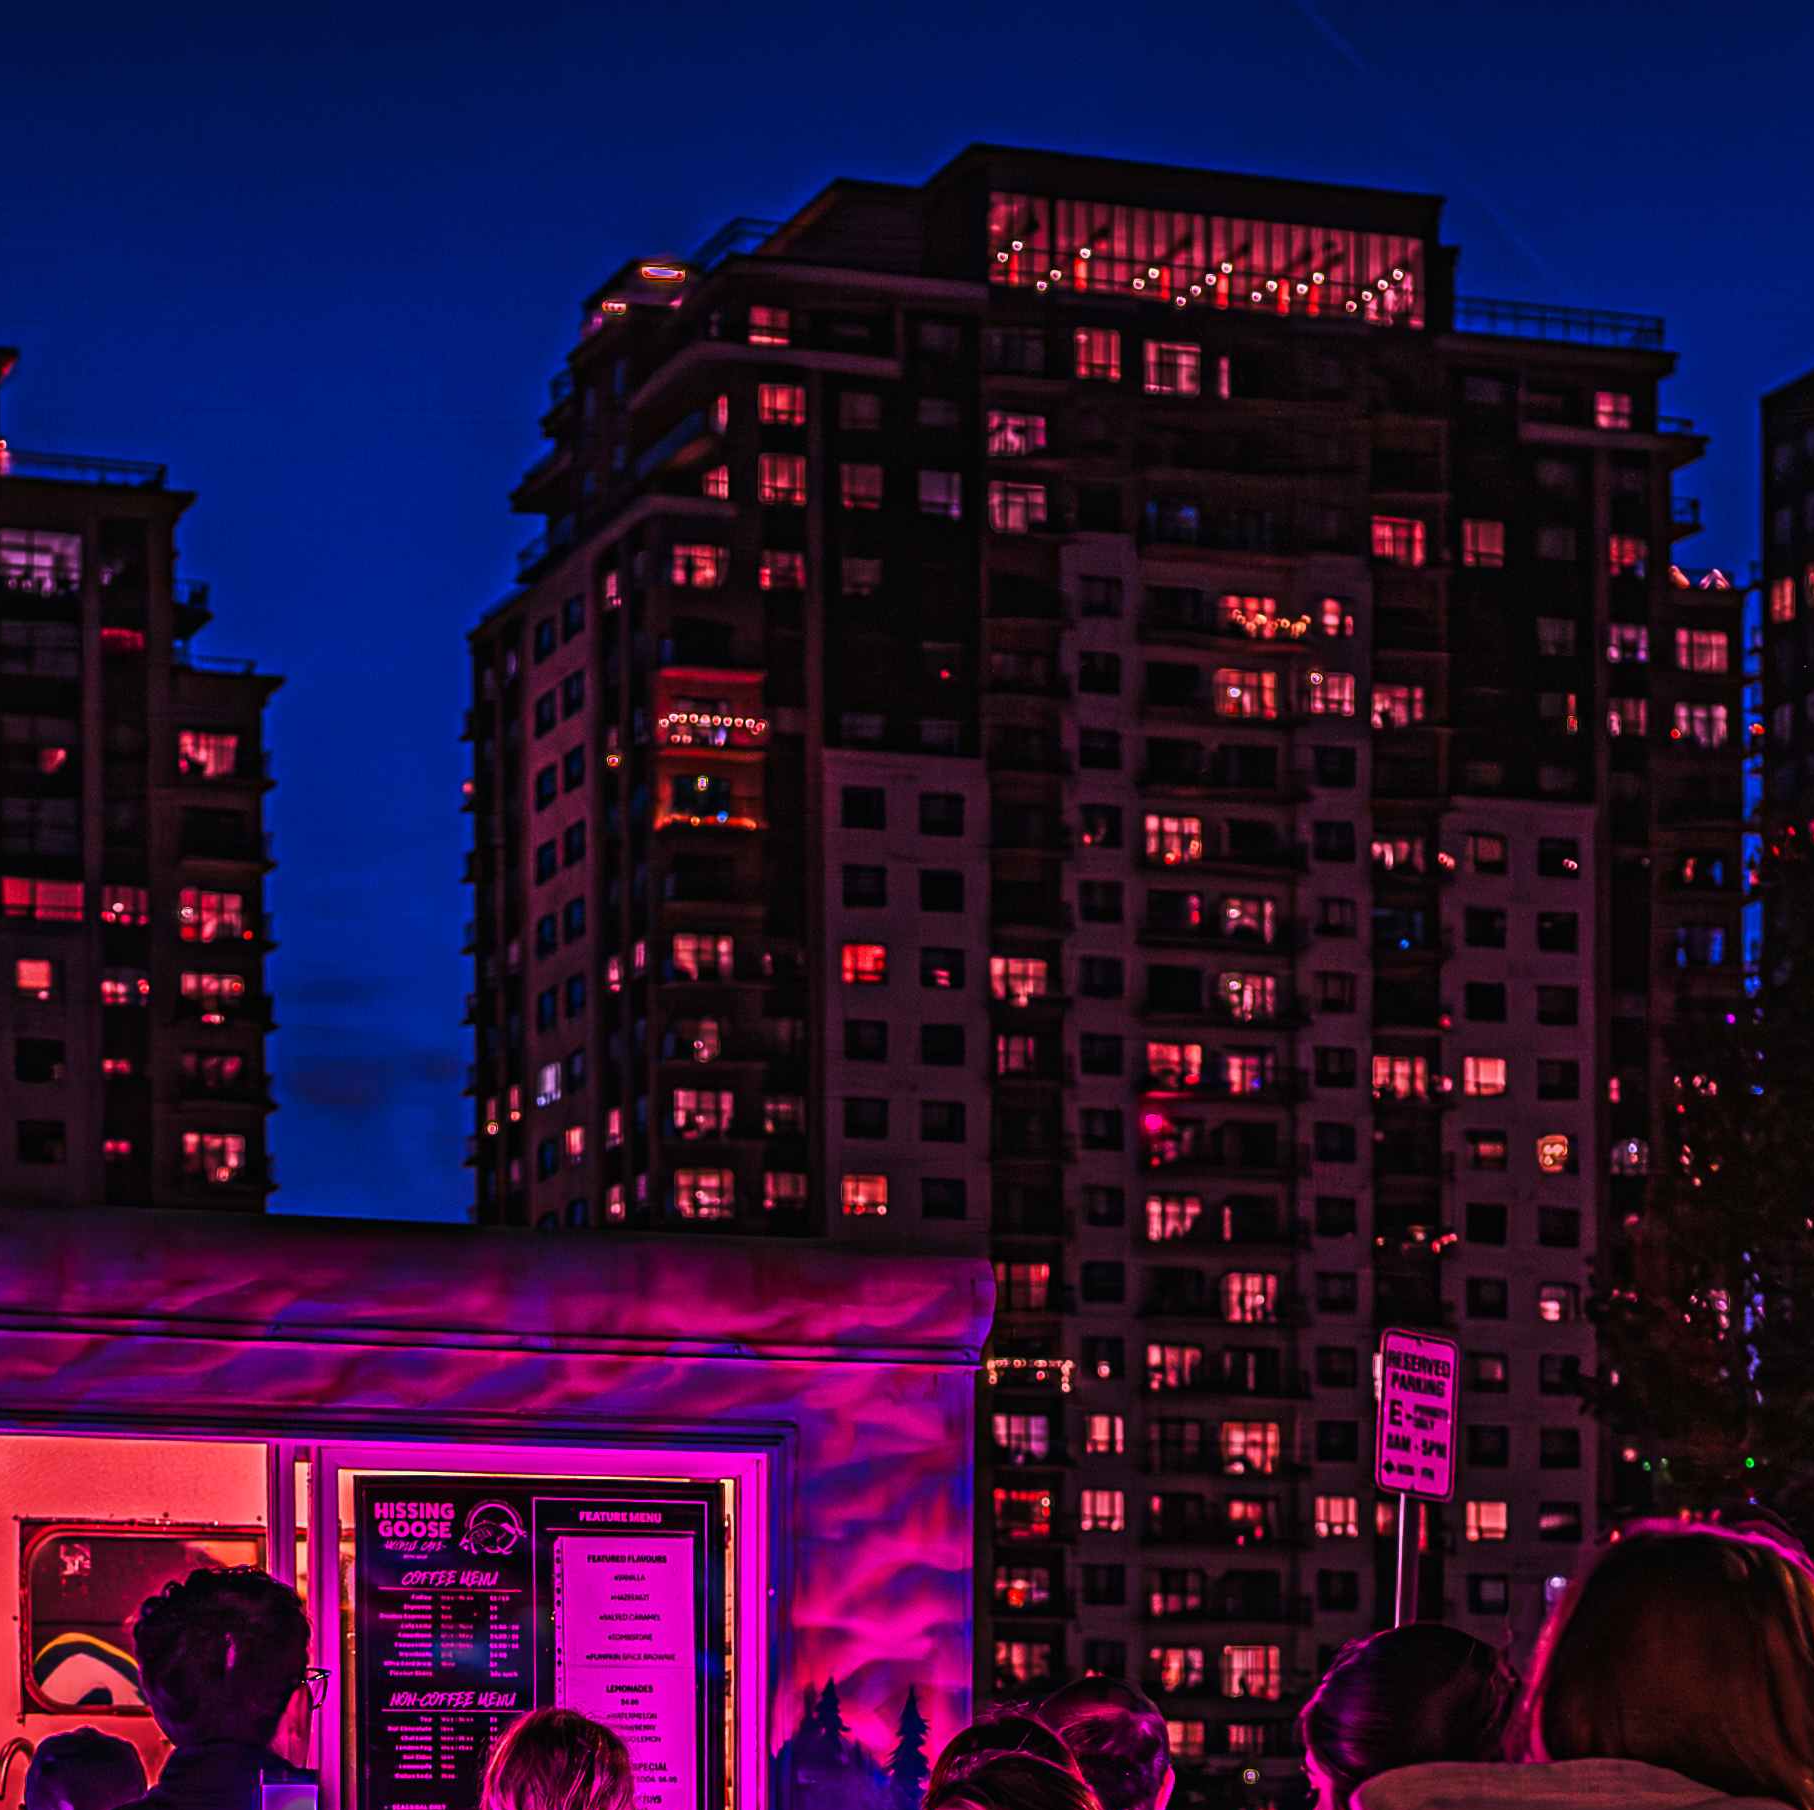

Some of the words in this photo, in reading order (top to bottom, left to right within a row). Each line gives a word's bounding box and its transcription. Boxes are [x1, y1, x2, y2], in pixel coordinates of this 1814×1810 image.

[1387, 1350, 1451, 1379] RESERVED
[1391, 1371, 1446, 1398] PARKING
[374, 1502, 456, 1520] HISSING
[579, 1511, 628, 1523] FEATURE
[629, 1512, 663, 1523] MENU
[378, 1520, 453, 1538] GOOSE
[401, 1570, 458, 1587] COFFEE
[459, 1570, 499, 1587] MENU
[389, 1691, 476, 1707] NON-COFFEE
[477, 1691, 517, 1707] MENU
